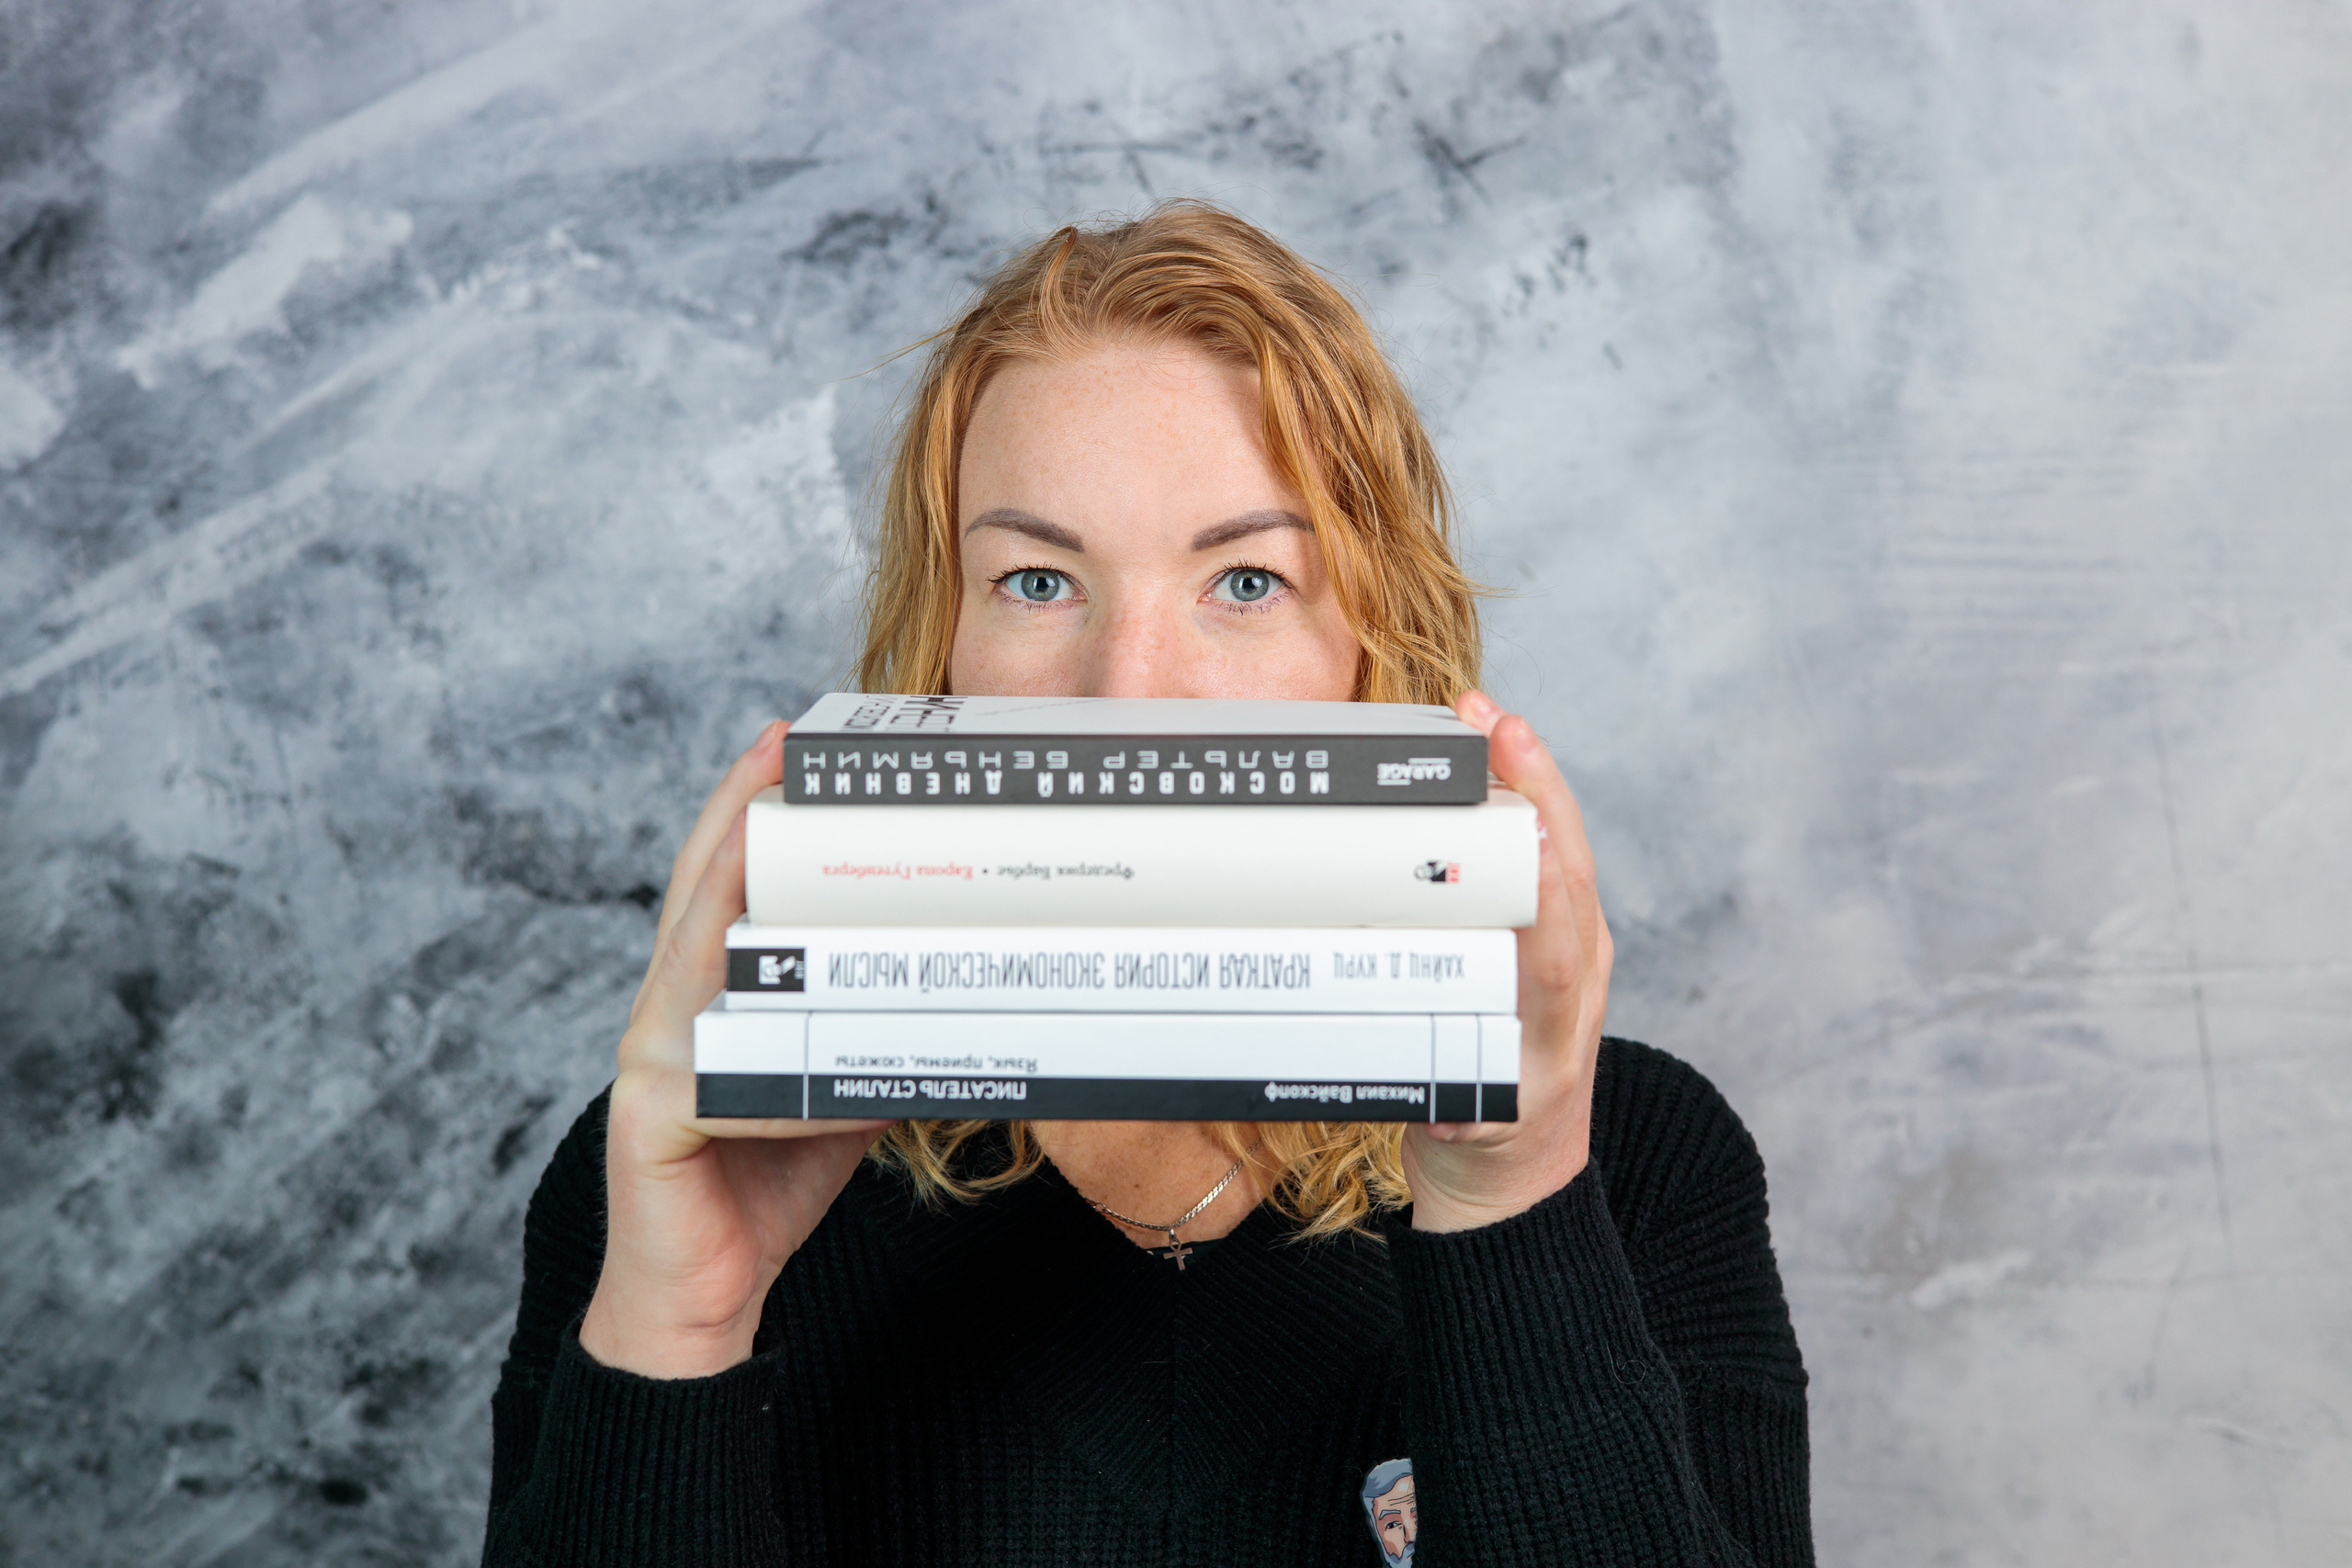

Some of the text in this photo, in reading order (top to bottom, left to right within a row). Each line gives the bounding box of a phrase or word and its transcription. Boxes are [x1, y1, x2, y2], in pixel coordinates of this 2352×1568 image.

[802, 750, 1330, 770] ВАЛЬТЕР БЕНЬЯМИН
[1376, 757, 1453, 787] GARAGE
[803, 770, 1330, 798] МОСКОВСКИЙ ДНЕВНИК
[821, 863, 1136, 881] Фредерик Барбье Европа Гутенберга
[828, 953, 910, 989] МЫСЛИ
[918, 953, 1106, 992] ЭКОНОМИЧЕСКОЙ
[1114, 953, 1211, 989] ИСТОРИЯ
[1219, 953, 1311, 989] КРАТКАЯ
[1333, 952, 1464, 983] ХАЙНЦ Д. КУРЦ
[834, 1054, 1040, 1073] Язык, приемы, сюжеты
[833, 1078, 1027, 1100] ПИСАТЕЛЬ СТАЛИН
[1265, 1080, 1426, 1105] Михаил Вайскопф
